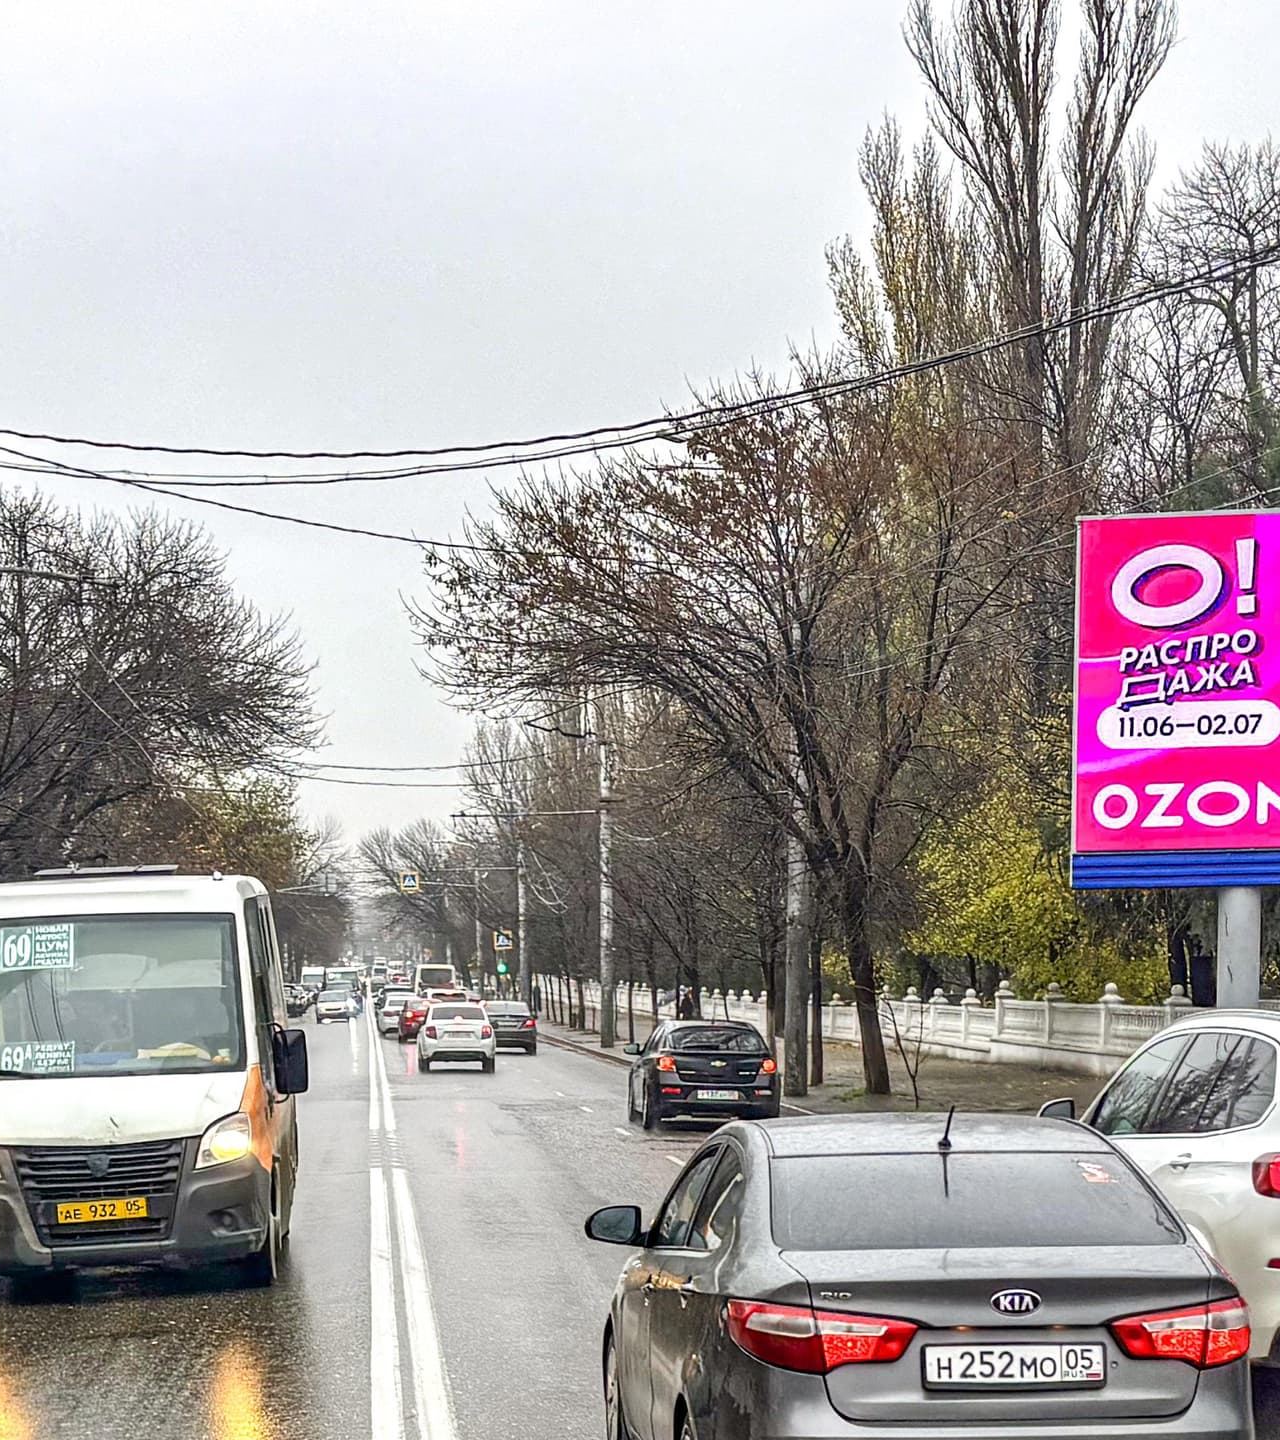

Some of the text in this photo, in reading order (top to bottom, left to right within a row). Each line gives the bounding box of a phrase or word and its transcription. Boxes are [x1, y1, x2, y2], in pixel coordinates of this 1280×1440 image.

[1119, 628, 1257, 673] РАСПРО
[1116, 658, 1255, 708] ДАЖА
[35, 940, 69, 953] ЦУМ
[999, 1295, 1034, 1311] KIA
[1065, 1348, 1094, 1371] 05
